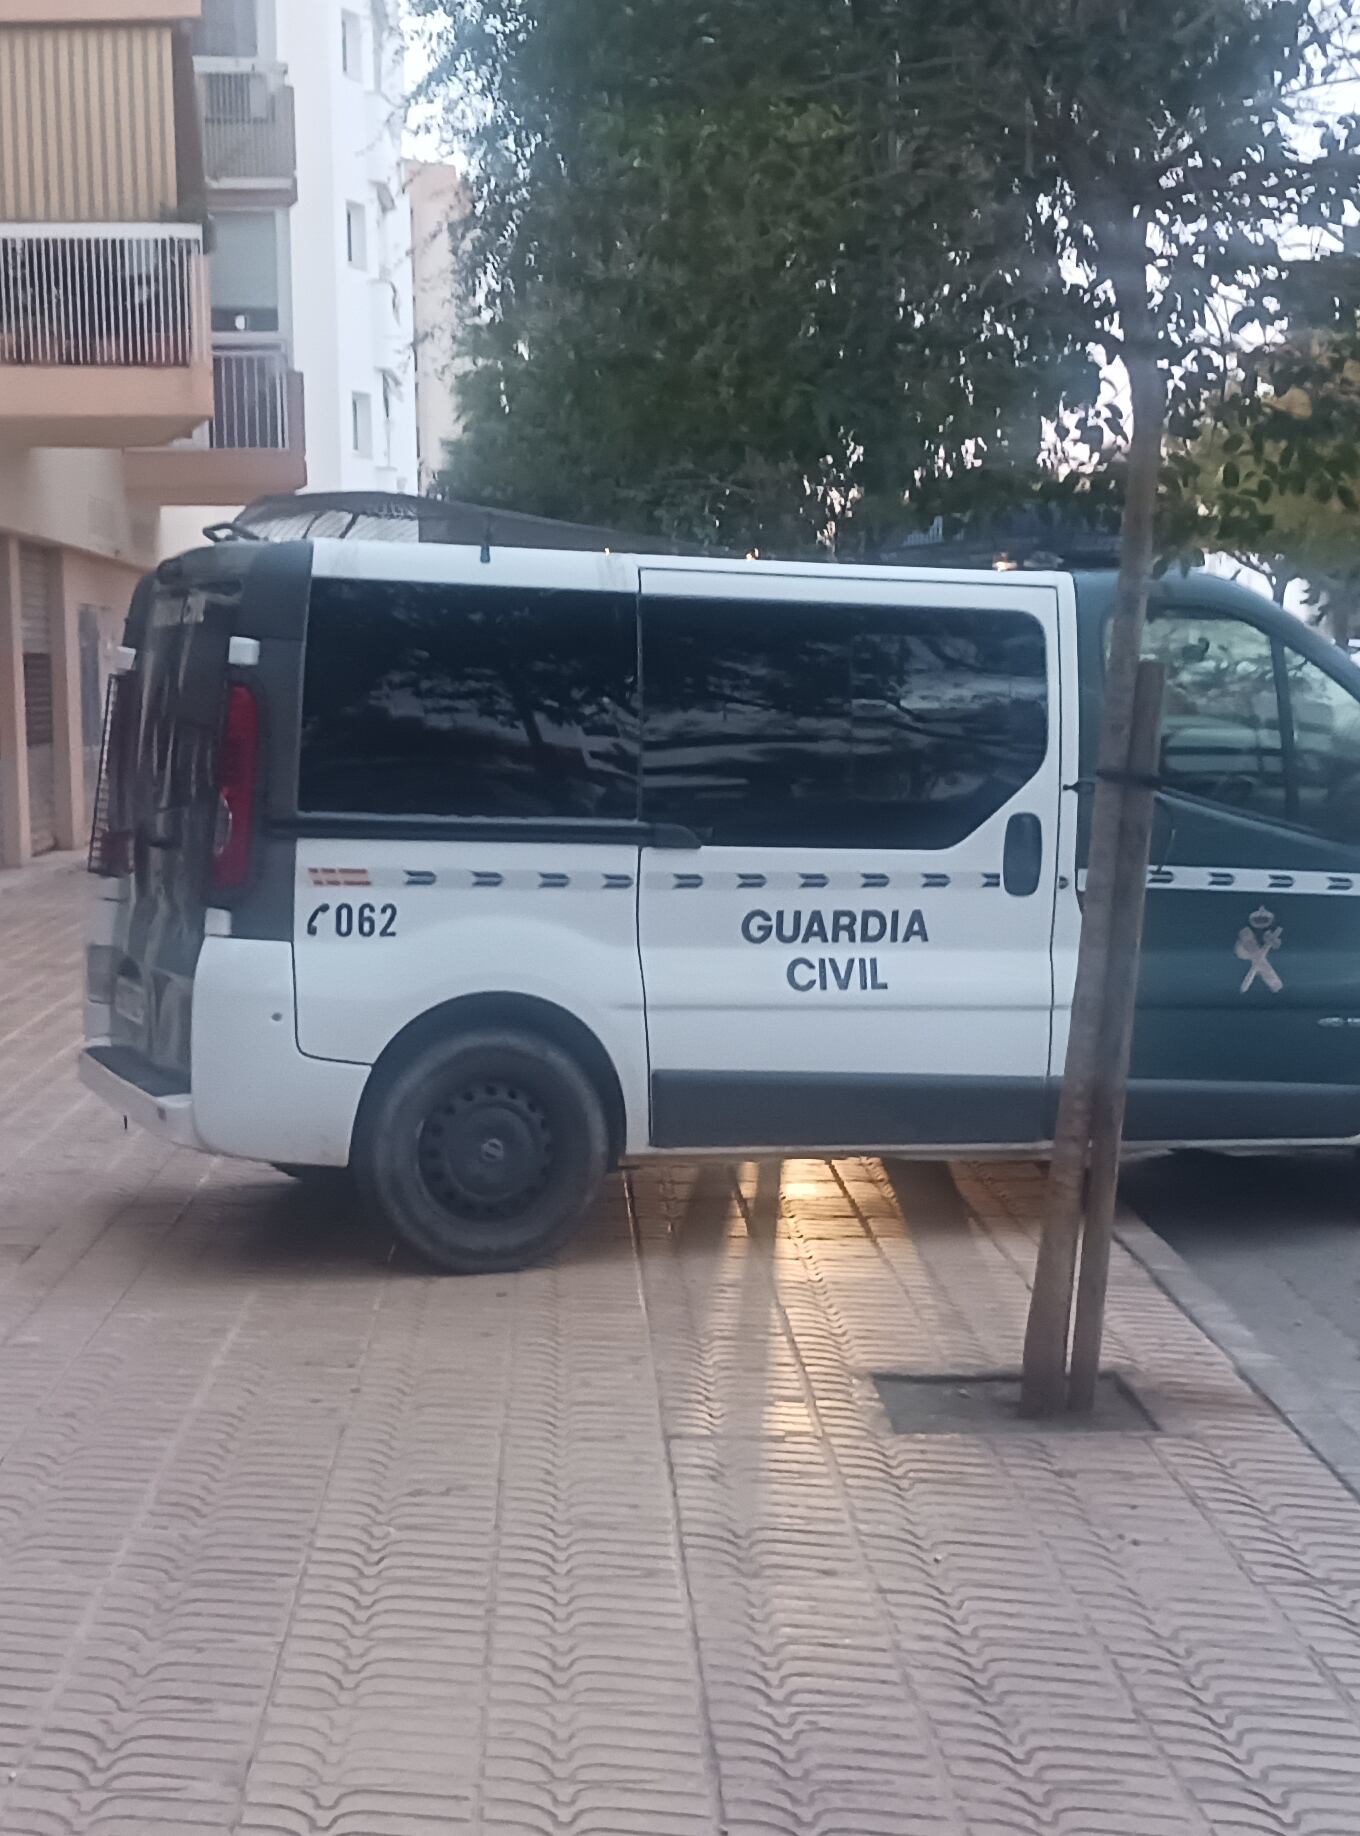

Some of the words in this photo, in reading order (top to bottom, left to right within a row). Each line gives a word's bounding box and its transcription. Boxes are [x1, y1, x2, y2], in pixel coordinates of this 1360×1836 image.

[335, 902, 397, 937] 062
[741, 908, 929, 944] GUARDIA
[786, 957, 888, 992] CIVIL
